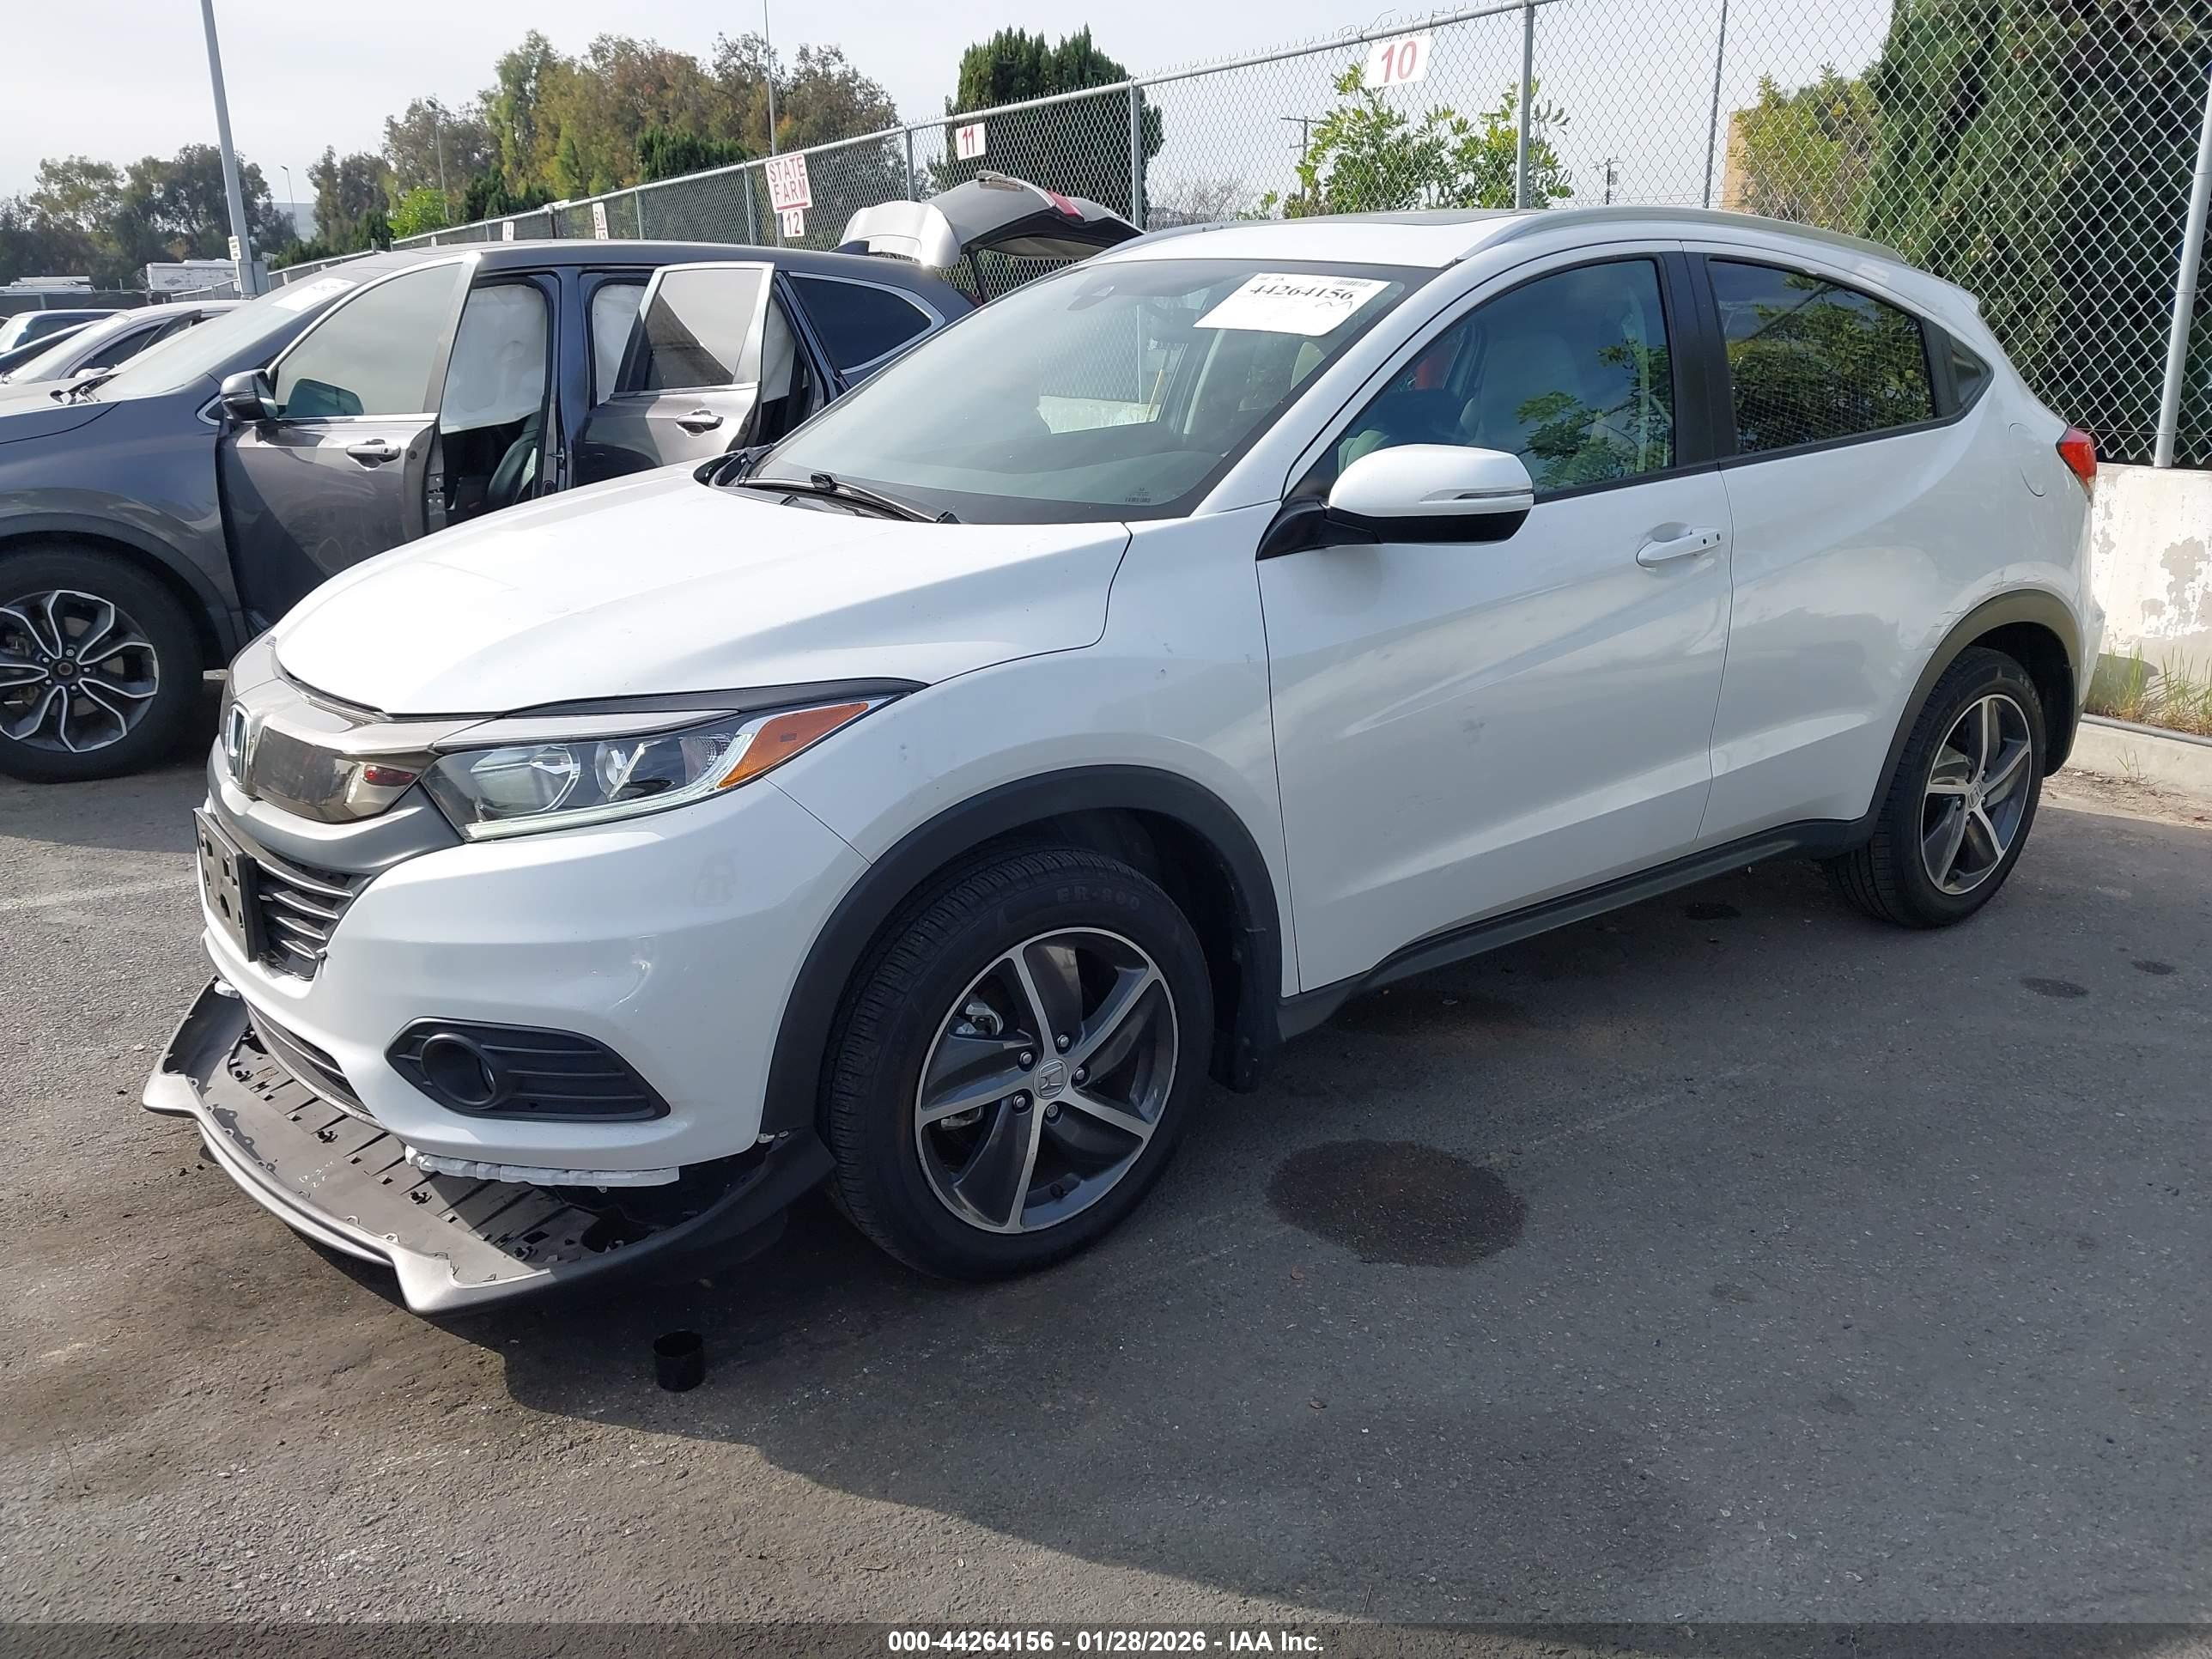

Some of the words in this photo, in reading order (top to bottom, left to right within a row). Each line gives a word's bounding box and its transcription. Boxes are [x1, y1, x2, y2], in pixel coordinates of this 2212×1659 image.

[1381, 40, 1417, 83] 10
[963, 125, 975, 155] 11
[769, 156, 805, 183] STATE
[774, 178, 809, 204] FARM
[786, 211, 801, 236] 12
[1250, 285, 1358, 300] 44264156
